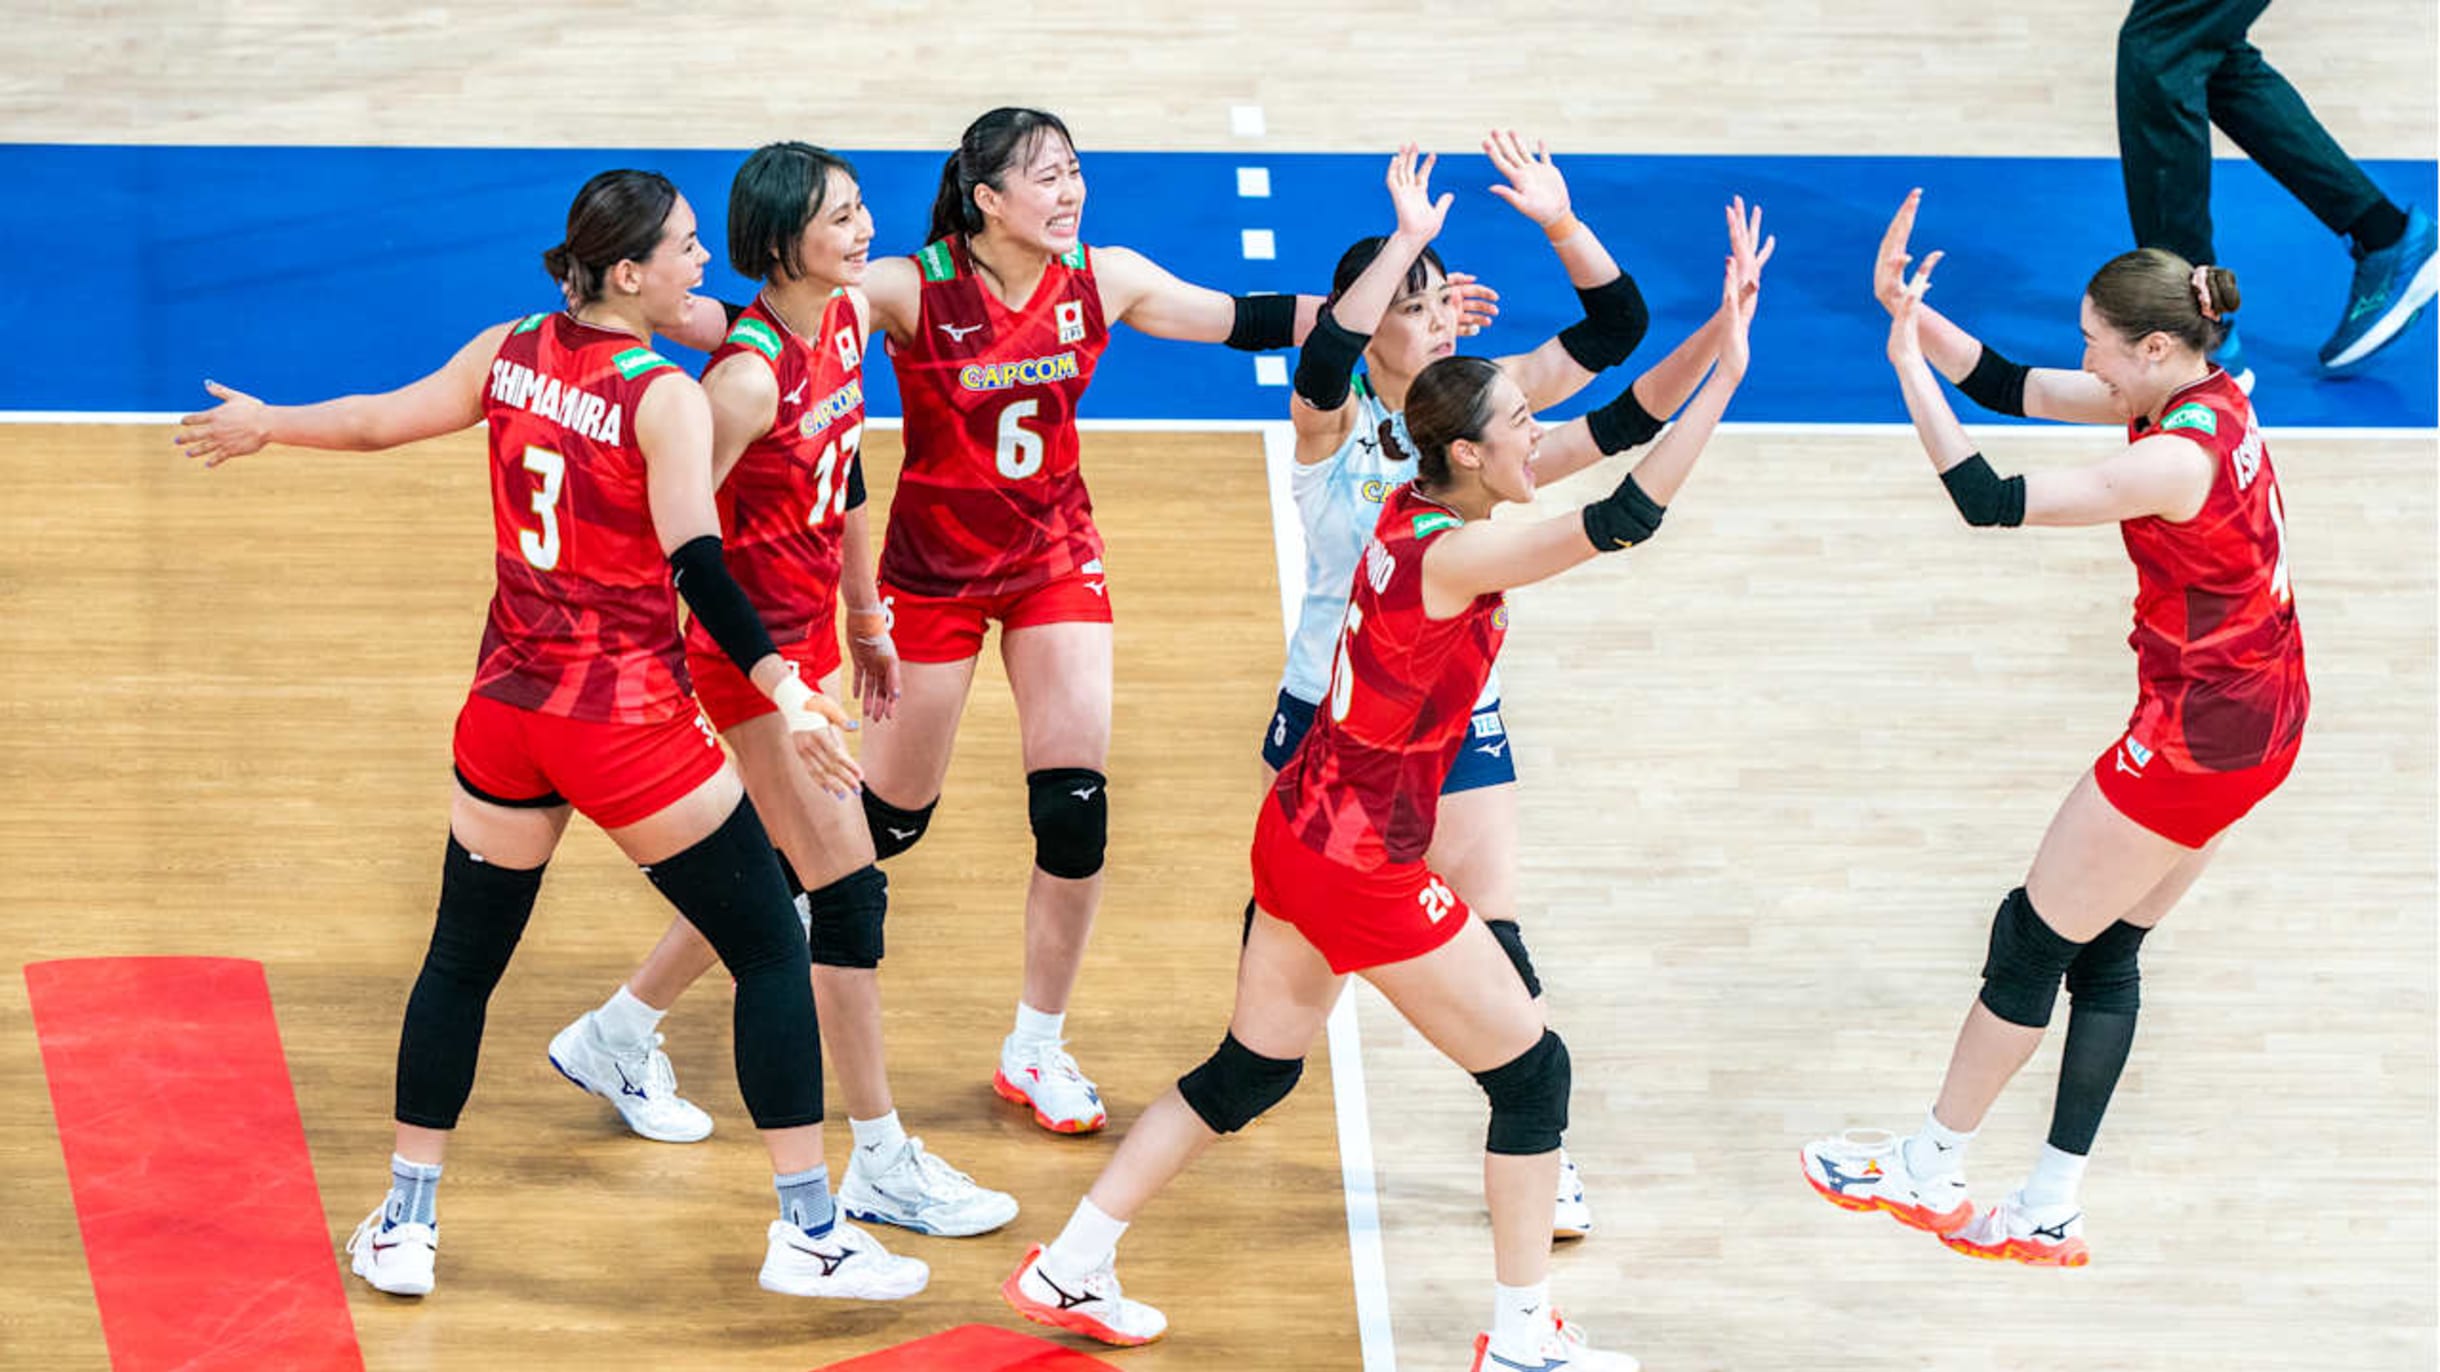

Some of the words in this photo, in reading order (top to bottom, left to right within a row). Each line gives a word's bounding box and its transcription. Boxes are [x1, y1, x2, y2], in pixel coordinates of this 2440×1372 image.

[960, 351, 1080, 391] CAPCOM
[799, 377, 864, 439] CAPCOM
[996, 399, 1044, 480] 6
[518, 445, 565, 571] 3
[1418, 877, 1455, 924] 26
